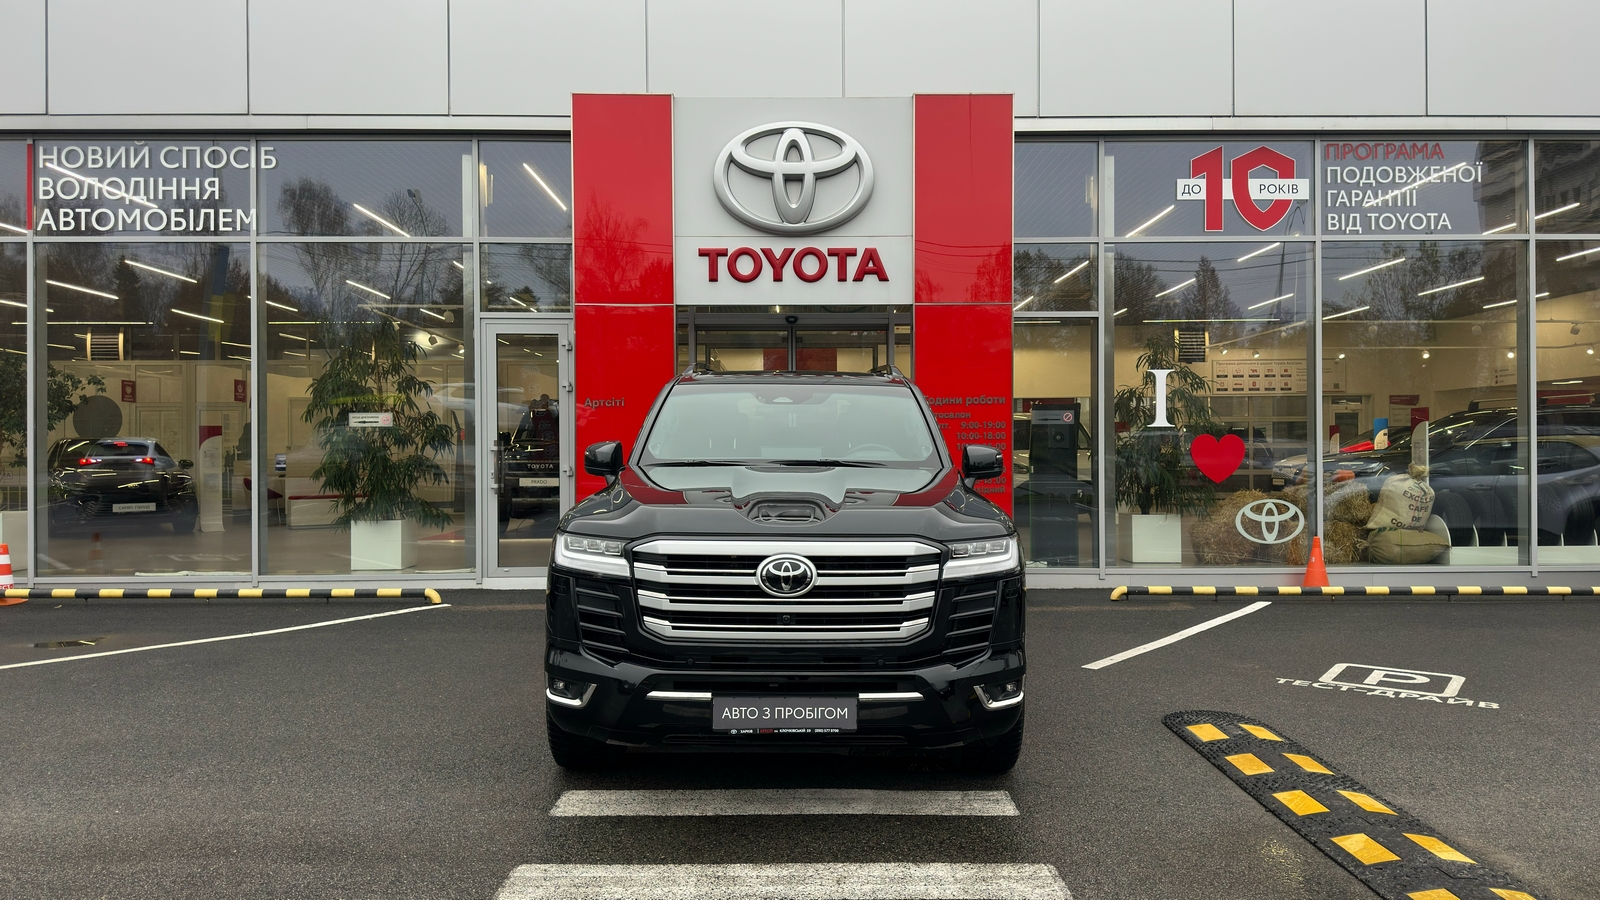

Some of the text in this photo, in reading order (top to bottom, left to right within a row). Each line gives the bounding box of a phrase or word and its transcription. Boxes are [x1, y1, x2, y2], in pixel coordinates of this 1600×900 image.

[38, 140, 278, 169] НОВИЙ СПОСІБ
[1325, 143, 1446, 161] ПРОГРАМА
[1327, 161, 1483, 186] ПОДОВЖЕНОЇ
[38, 177, 221, 205] ВОЛОДІННЯ
[1181, 184, 1202, 197] ДО
[1258, 183, 1299, 195] РОКІВ
[1327, 187, 1418, 208] ГАРАНТІЇ
[37, 208, 257, 231] АВТОМОБІЛЕМ
[1327, 213, 1452, 234] ВІД TOYOTA
[698, 247, 890, 284] TOYOTA
[584, 397, 626, 410] Артсіті
[965, 394, 1006, 407] роботи
[1146, 368, 1176, 428] I
[960, 421, 1007, 429] 9:00-19:00
[956, 431, 1007, 440] 10:00-18:00
[1411, 515, 1423, 523] DE
[1362, 669, 1431, 685] P
[1275, 677, 1500, 709] ТЕСТ-ДРАЙВ
[721, 707, 759, 720] АВТО
[774, 707, 849, 720] ПРОБІГОМ
